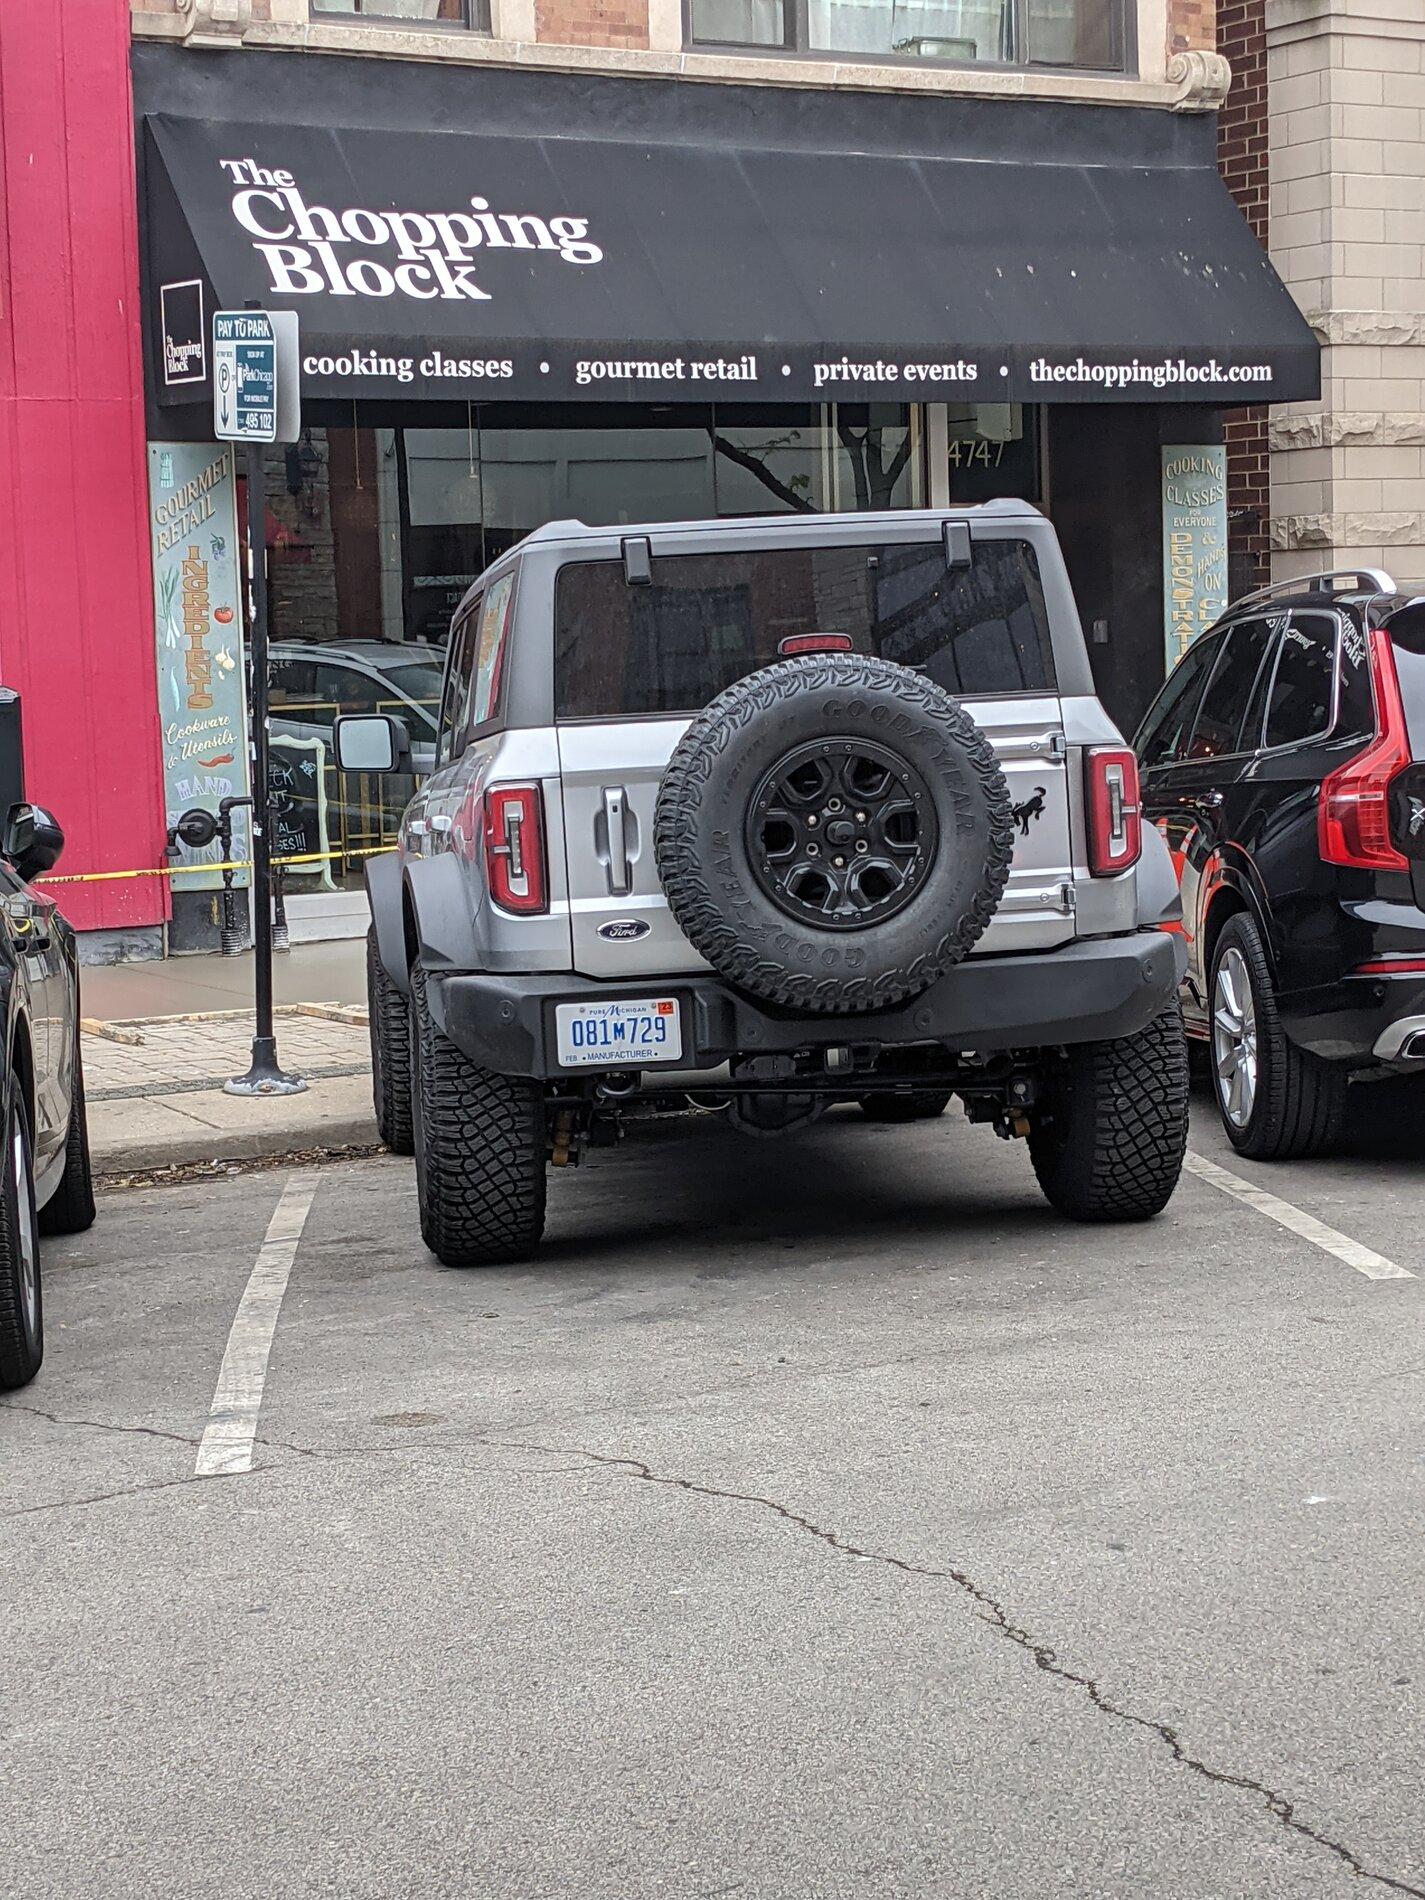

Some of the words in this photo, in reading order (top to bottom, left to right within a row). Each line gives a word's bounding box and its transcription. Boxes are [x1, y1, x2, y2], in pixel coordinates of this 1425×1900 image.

[219, 158, 296, 188] The
[231, 187, 604, 264] Chopping
[253, 240, 492, 300] Block
[217, 320, 233, 338] PAY
[234, 318, 247, 338] TO
[247, 319, 271, 338] PARK
[166, 340, 202, 359] Chopping
[168, 358, 190, 373] Block
[302, 350, 414, 382] cooking
[419, 352, 514, 378] classes
[575, 357, 686, 384] gourmet
[689, 356, 758, 381] retail
[813, 356, 898, 387] private
[903, 362, 979, 382] events
[1029, 358, 1274, 388] thechoppingblock.com
[245, 413, 259, 428] 495
[259, 413, 272, 429] 102
[947, 440, 1004, 468] 4747
[1166, 456, 1223, 480] COOKING
[155, 452, 229, 525] GOURMET
[1167, 484, 1224, 507] CLASSES
[157, 495, 216, 559] RETAIL
[1173, 517, 1217, 527] EVERYONE
[1202, 532, 1216, 545] &
[1197, 547, 1226, 578] HANDS
[1204, 573, 1221, 592] ON
[182, 546, 214, 709] INGREDIENTS
[165, 716, 231, 745] Cookware
[180, 729, 238, 760] Utensils
[821, 699, 972, 836] GOODYEAR
[174, 776, 232, 801] HAND
[609, 923, 638, 938] Ford
[603, 1004, 647, 1018] MICHIGAN
[571, 1017, 667, 1047] 081M729
[587, 1050, 653, 1061] MANUFACTURER
